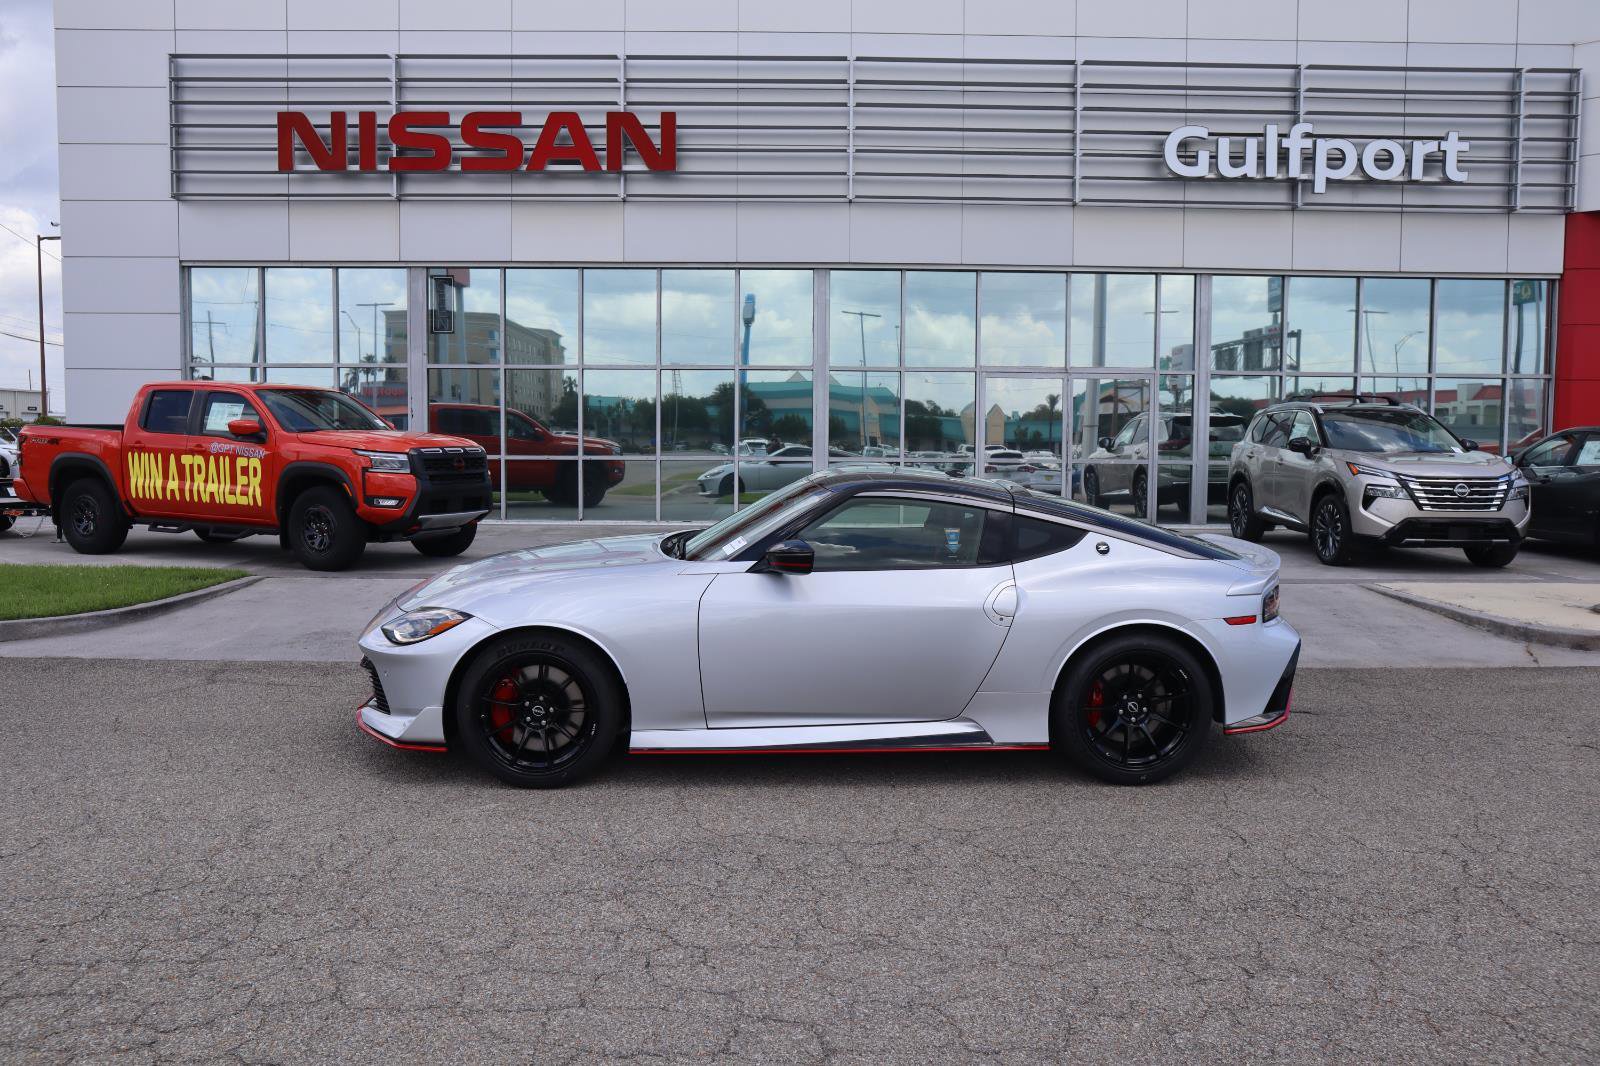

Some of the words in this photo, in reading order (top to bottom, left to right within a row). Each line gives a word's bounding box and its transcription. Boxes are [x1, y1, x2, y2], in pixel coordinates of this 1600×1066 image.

[277, 111, 677, 172] NISSAN
[1163, 122, 1470, 194] Gulfport
[127, 451, 163, 500] WIN
[166, 453, 180, 501] A
[180, 454, 262, 507] TRAILER
[210, 442, 235, 454] @GPT
[235, 446, 265, 459] NISSAN
